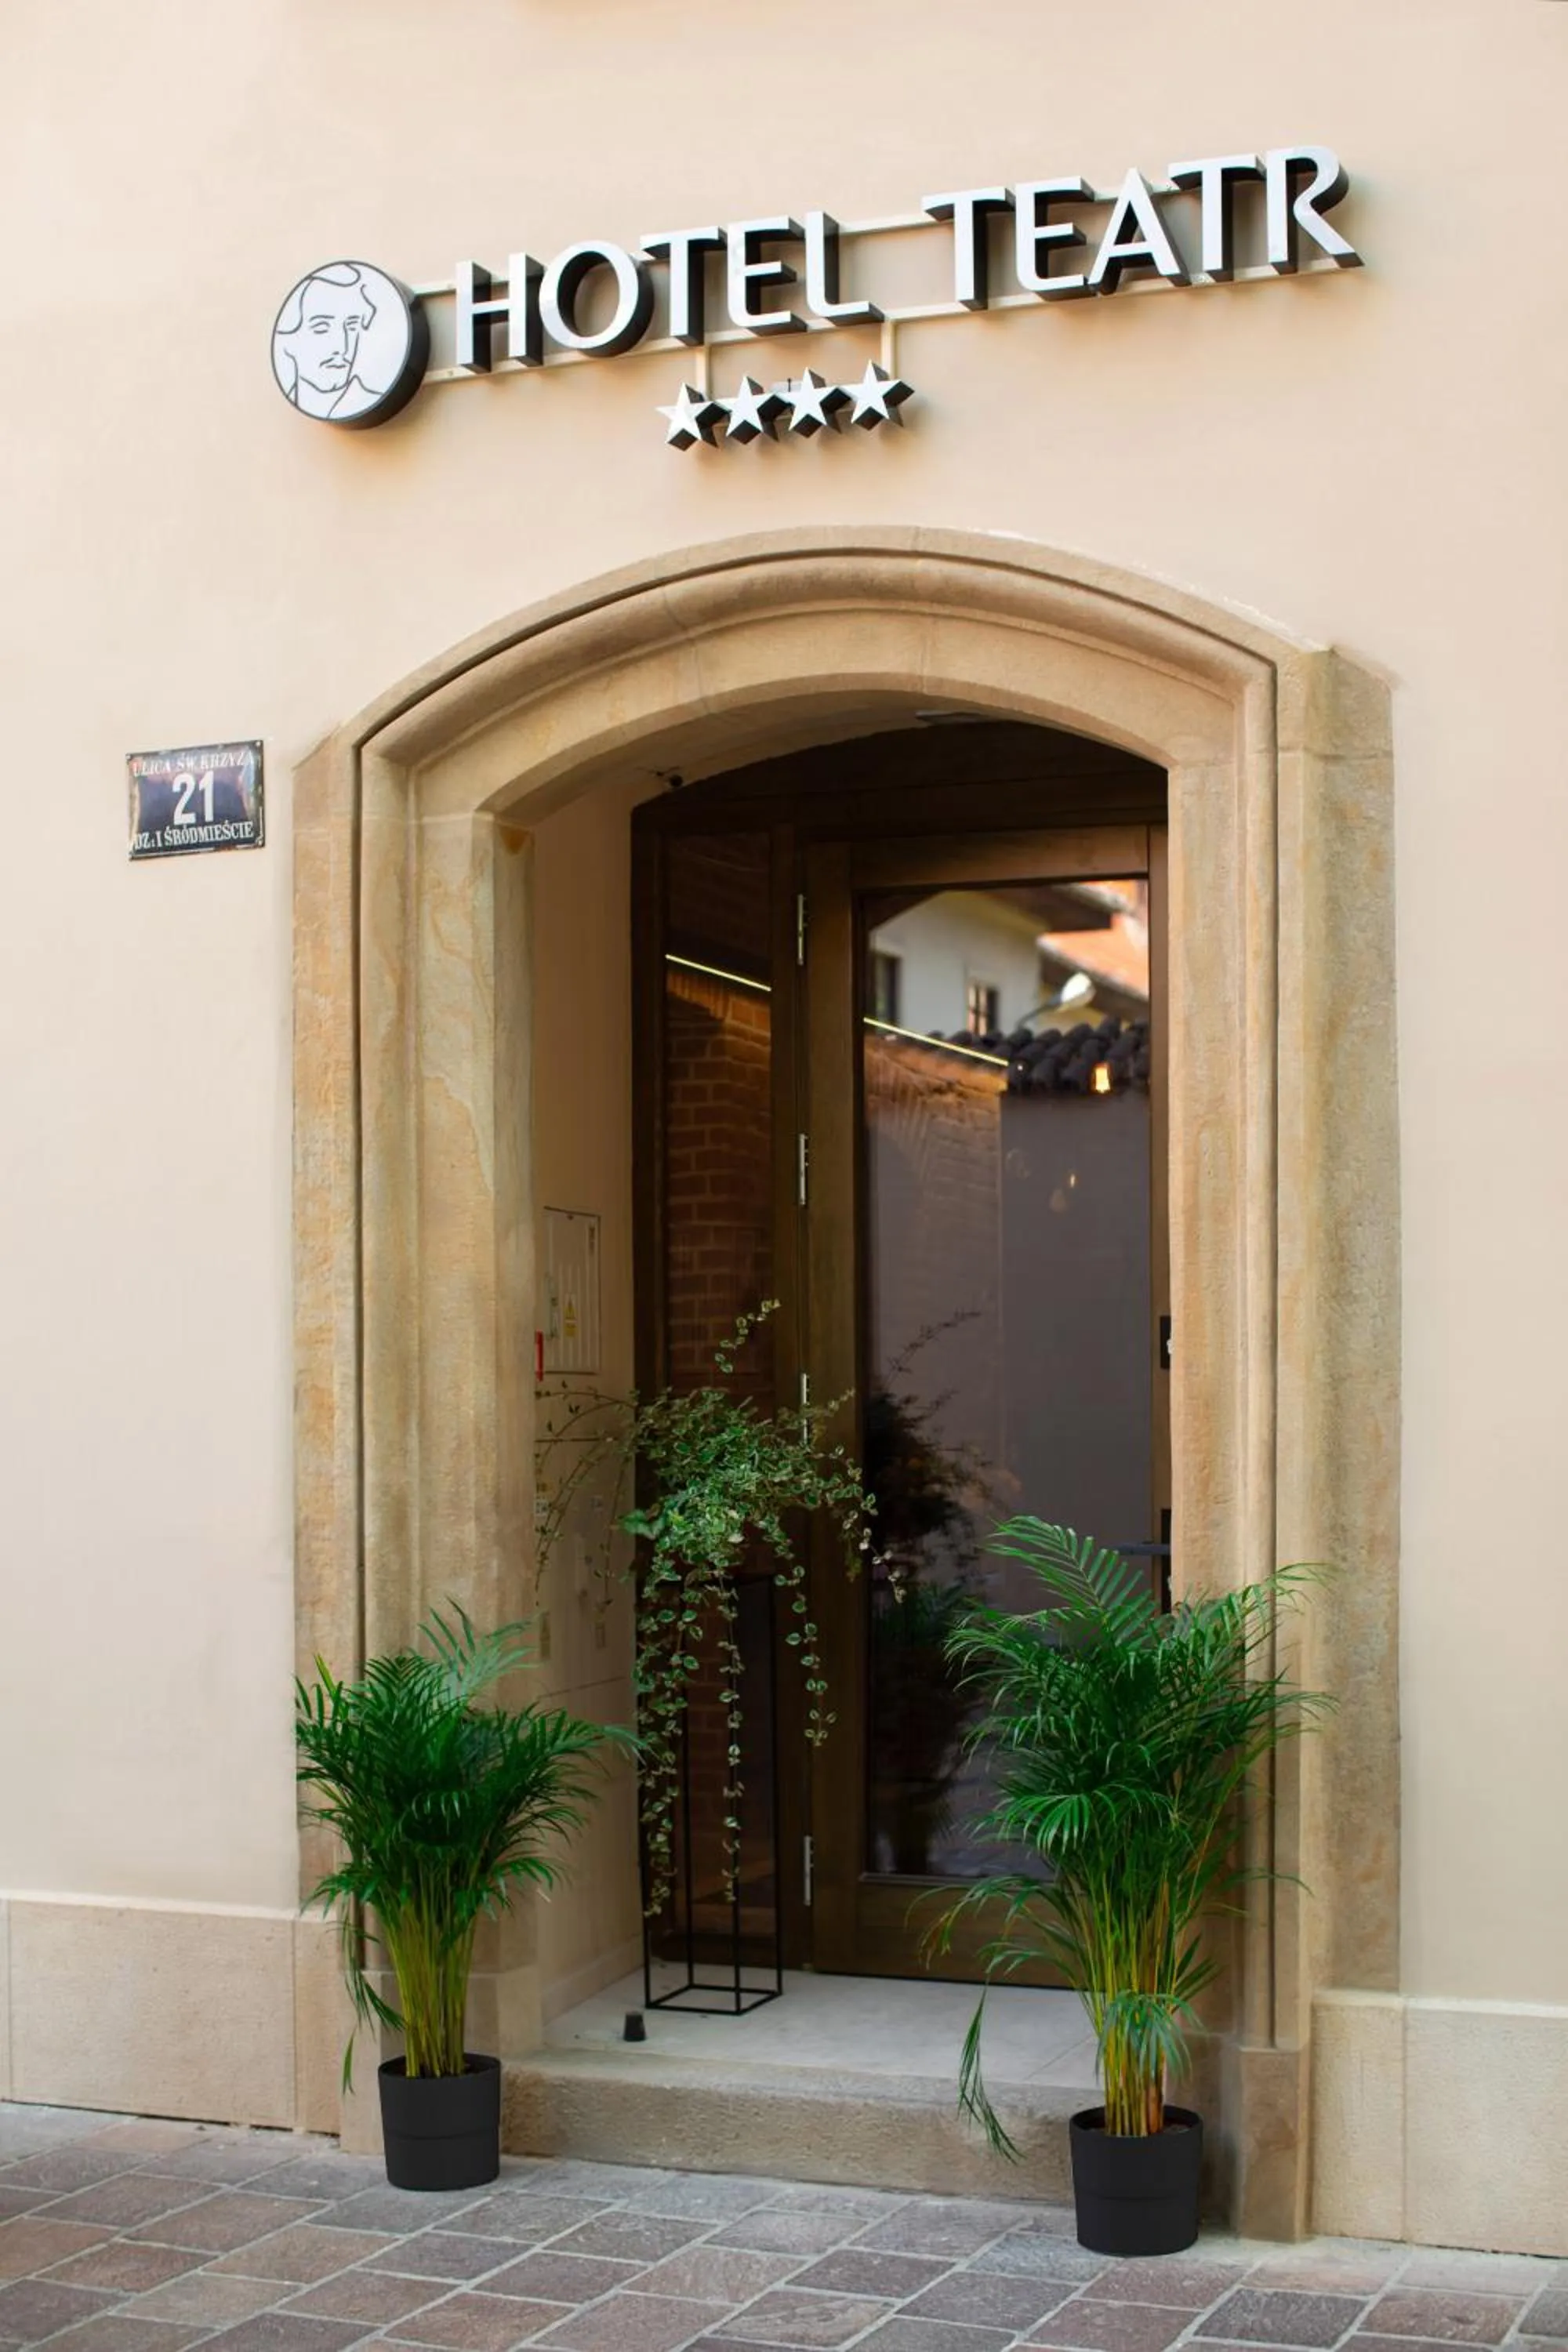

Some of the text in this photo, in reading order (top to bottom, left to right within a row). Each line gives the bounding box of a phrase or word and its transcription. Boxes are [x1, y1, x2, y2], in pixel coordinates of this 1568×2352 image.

[456, 145, 1361, 370] HOTEL TEATR
[132, 760, 172, 777] ULICA
[172, 771, 214, 825] 21
[164, 820, 253, 845] ŚRÓDMIEŚCIE
